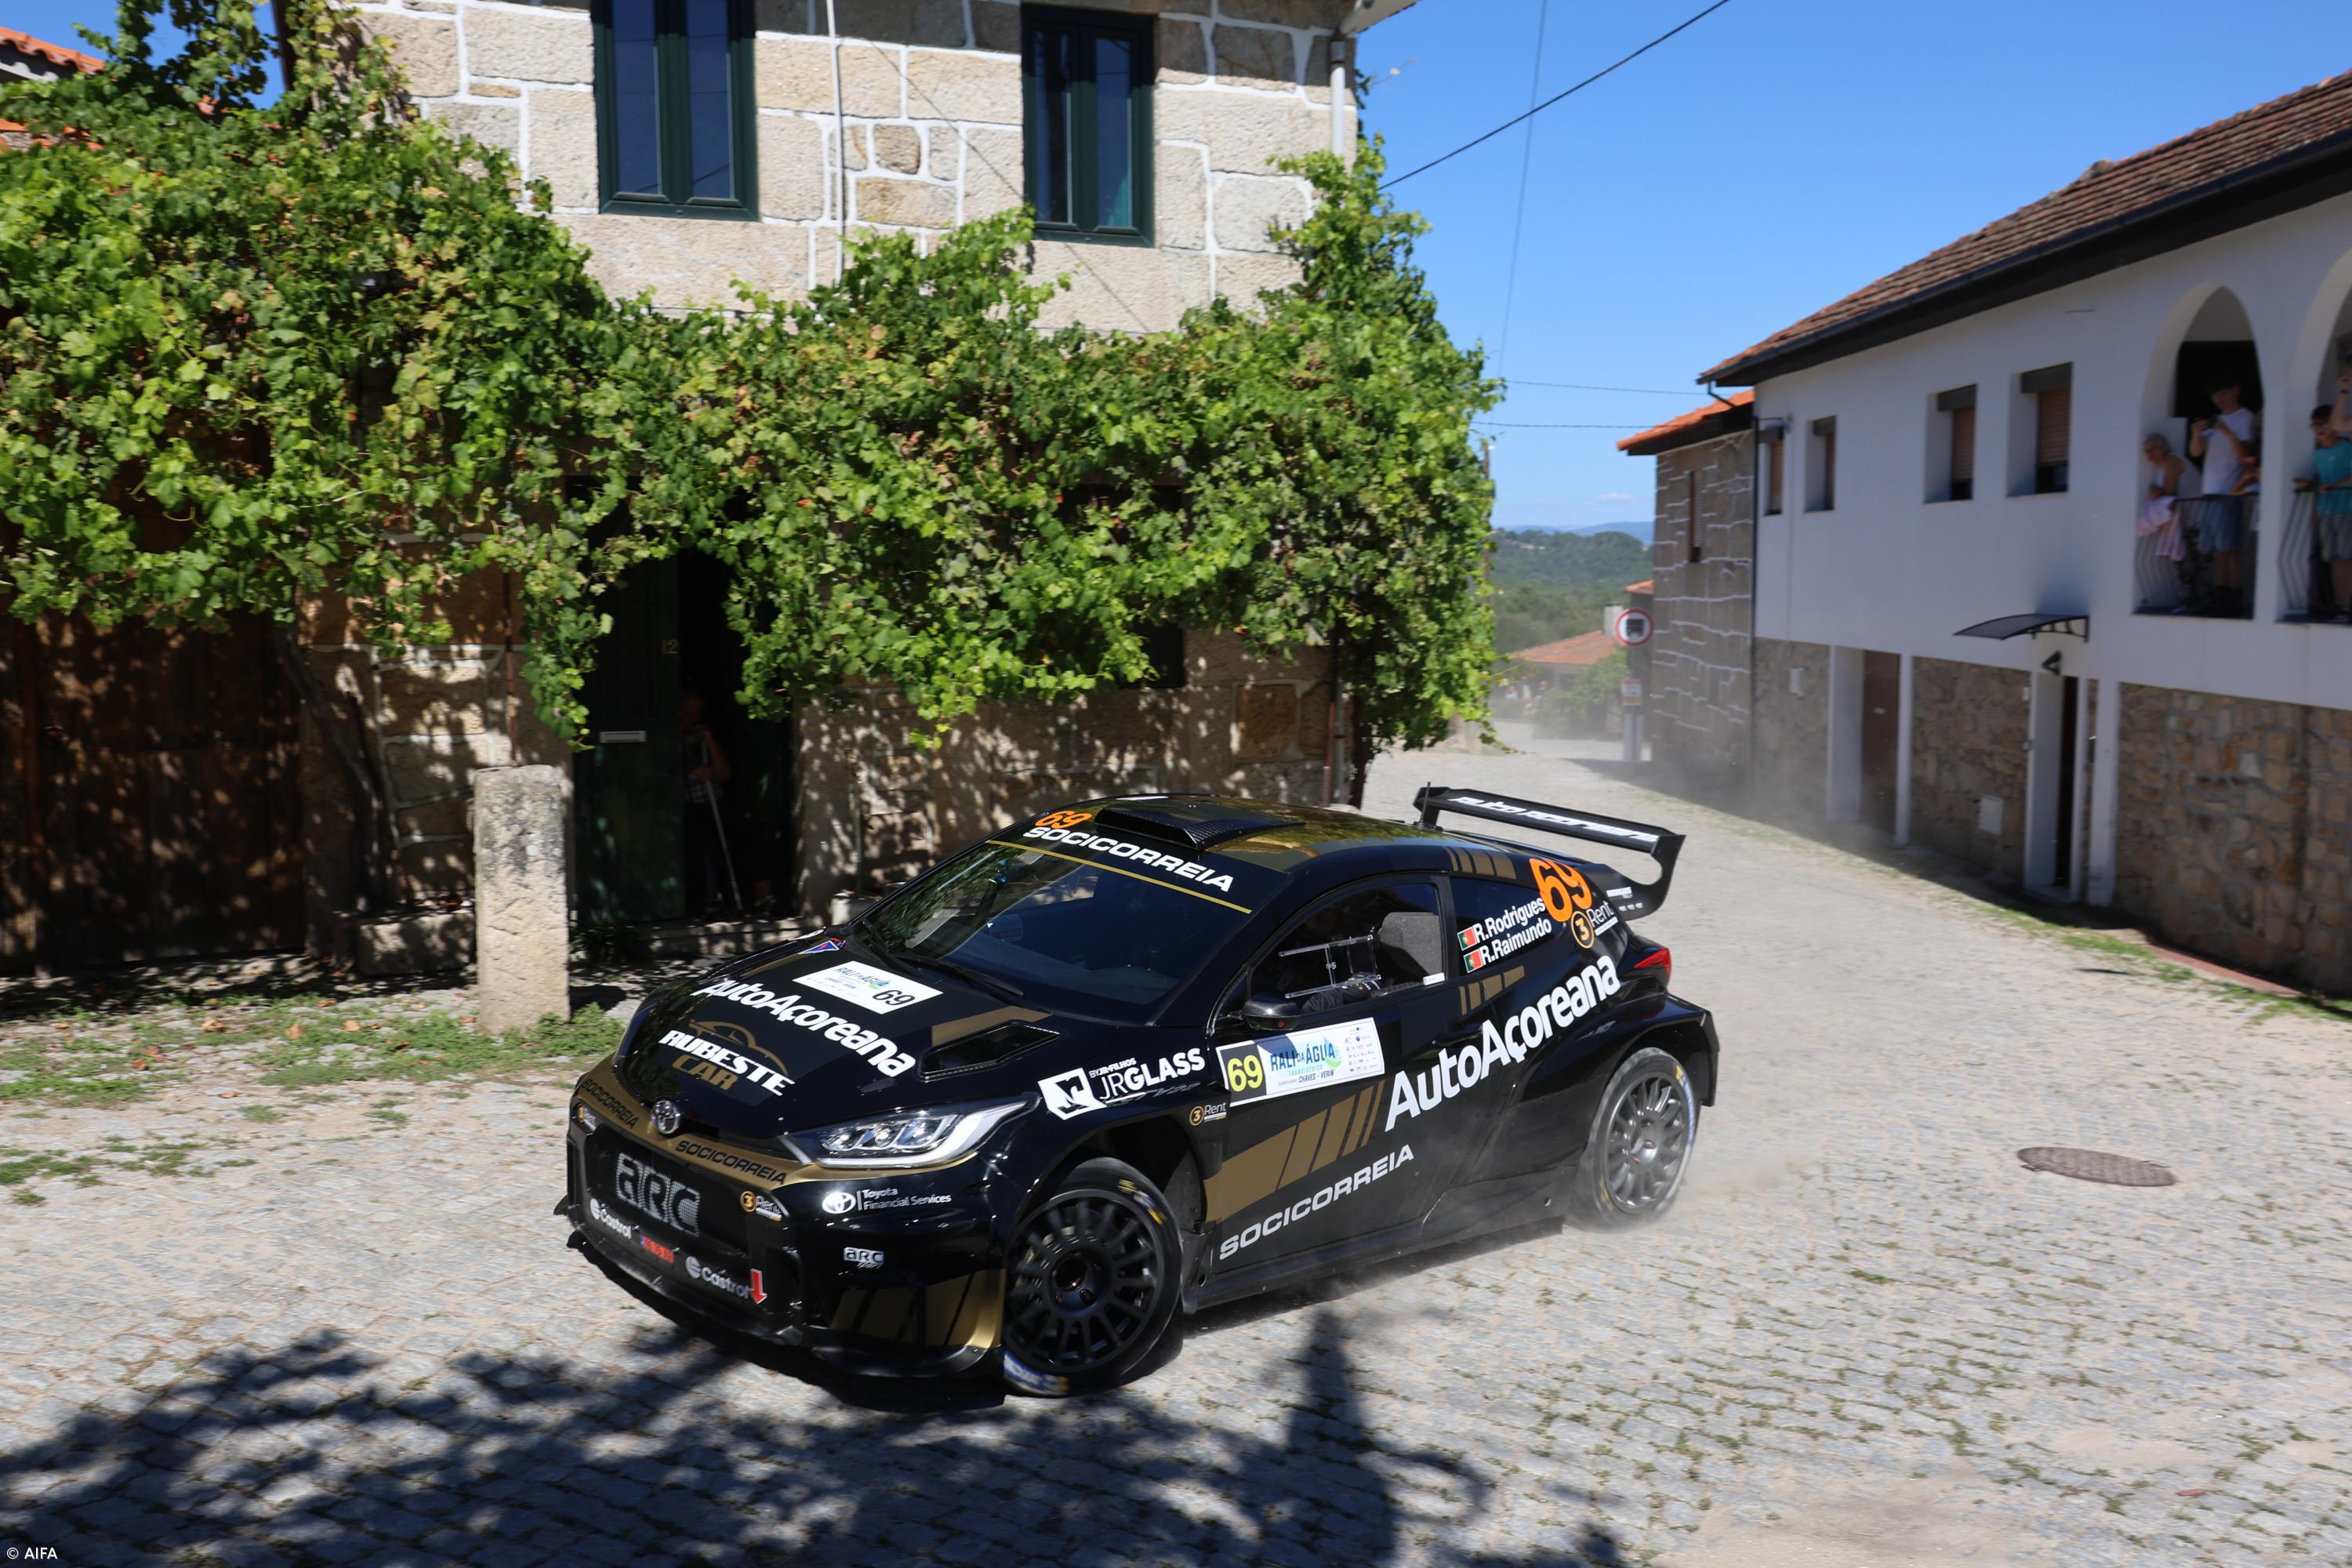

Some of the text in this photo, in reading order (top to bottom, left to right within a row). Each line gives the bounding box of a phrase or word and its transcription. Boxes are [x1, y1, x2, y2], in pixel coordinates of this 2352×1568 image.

[1035, 810, 1092, 829] 69
[1023, 826, 1233, 892] SOCICORREIA
[1530, 858, 1592, 922] 69
[1472, 897, 1545, 943] R.Rodrigues
[1587, 902, 1614, 927] Rent
[1479, 917, 1552, 966] R.Raimundo
[873, 990, 915, 1006] 69
[690, 978, 916, 1077] AutoAçoreana
[1385, 955, 1621, 1133] AutoAçoreana
[658, 1030, 796, 1096] RUBESTE
[672, 1054, 739, 1091] CAR
[1227, 1054, 1263, 1092] 69
[1270, 1051, 1296, 1071] RALI
[1305, 1043, 1335, 1065] ÁGUA
[582, 1079, 640, 1129] SOCICORREIA
[1204, 1102, 1227, 1115] Rent
[676, 1141, 787, 1185] SOCICORREIA
[862, 1188, 898, 1200] Toyota
[863, 1194, 952, 1210] Financial Services
[1220, 1144, 1414, 1260] SOCICORREIA
